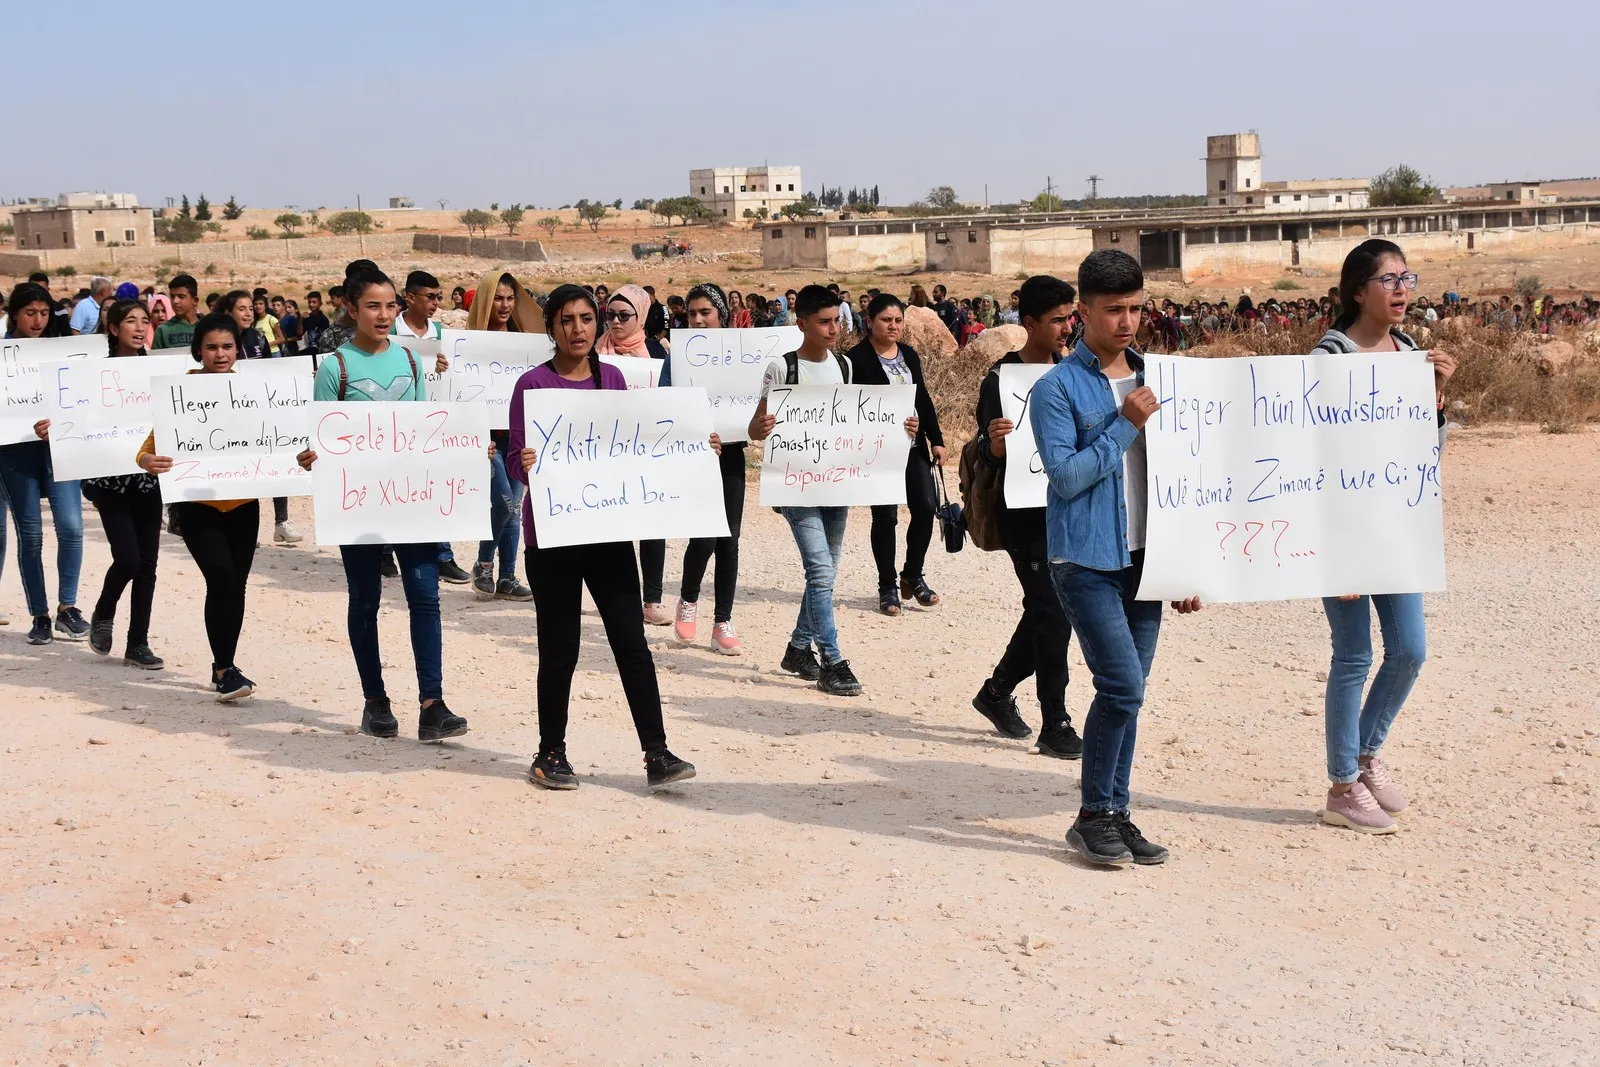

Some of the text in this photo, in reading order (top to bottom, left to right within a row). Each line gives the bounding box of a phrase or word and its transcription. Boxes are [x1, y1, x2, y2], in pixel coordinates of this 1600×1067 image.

[453, 338, 480, 374] Em
[58, 367, 90, 409] Em
[170, 385, 219, 423] Heger
[1158, 362, 1232, 457] Heger
[56, 421, 119, 441] Zimanê
[317, 411, 384, 455] Gelê
[422, 410, 482, 453] Ziman
[651, 419, 708, 458] Ziman
